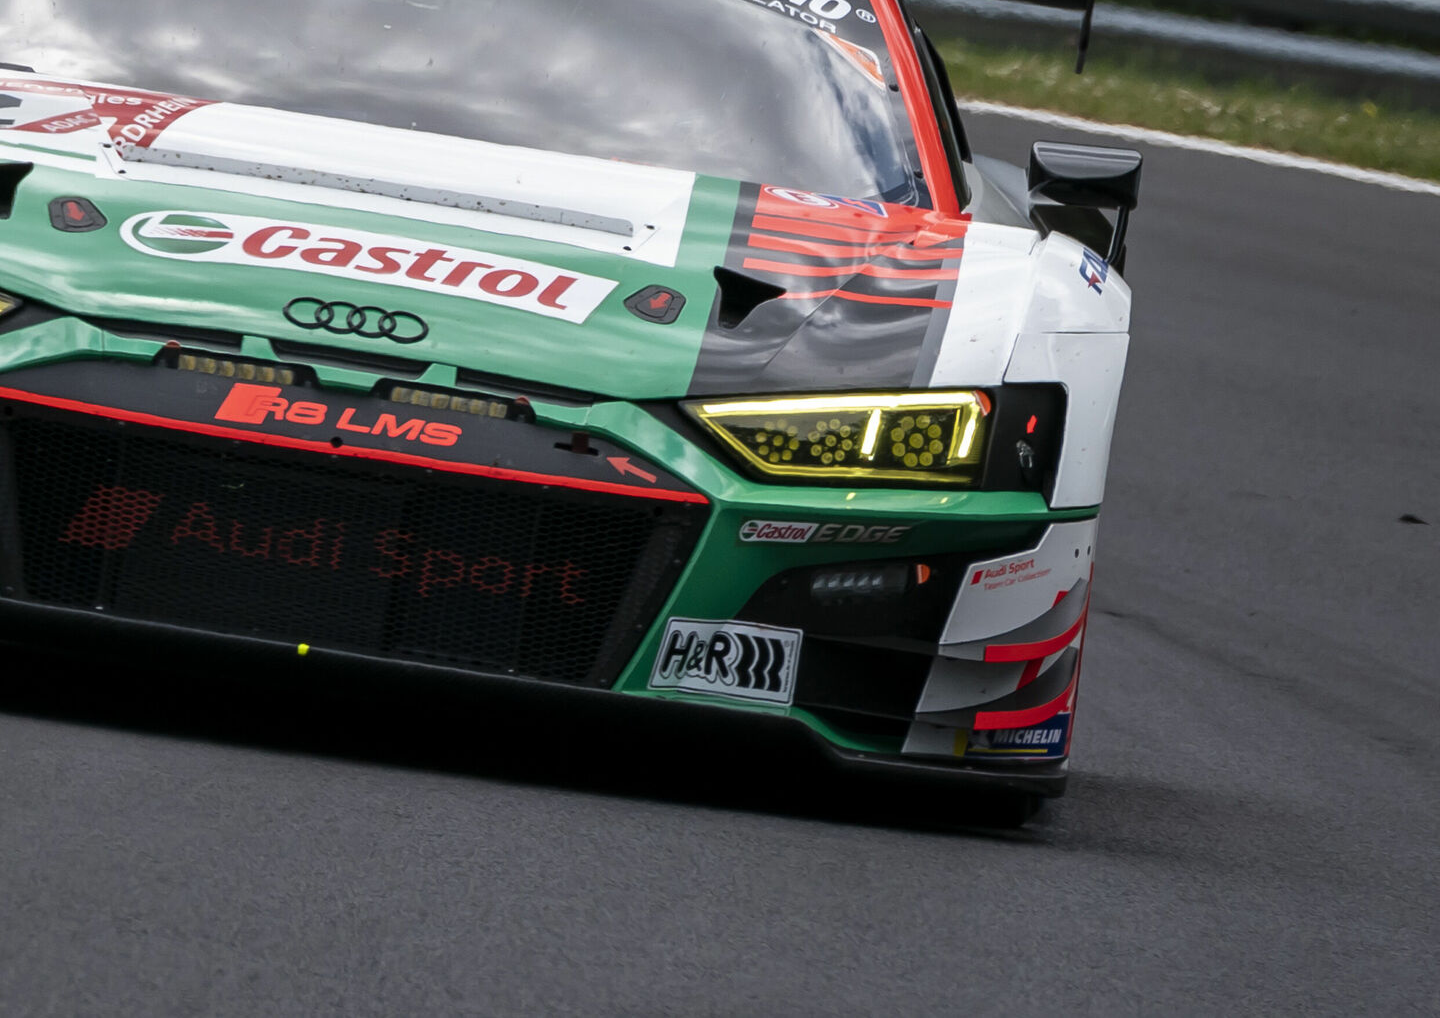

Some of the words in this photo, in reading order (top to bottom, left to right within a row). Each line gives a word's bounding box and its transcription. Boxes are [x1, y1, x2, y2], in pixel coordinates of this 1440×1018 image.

[241, 225, 580, 311] Castrol
[246, 394, 328, 426] R8
[335, 407, 463, 447] LMS
[169, 501, 347, 570] Audi
[369, 526, 590, 607] Sport
[755, 523, 813, 541] Castrol
[812, 522, 913, 543] EDGE
[1009, 559, 1035, 575] Sport
[660, 631, 734, 678] H&R
[992, 728, 1063, 744] MICHELIN
